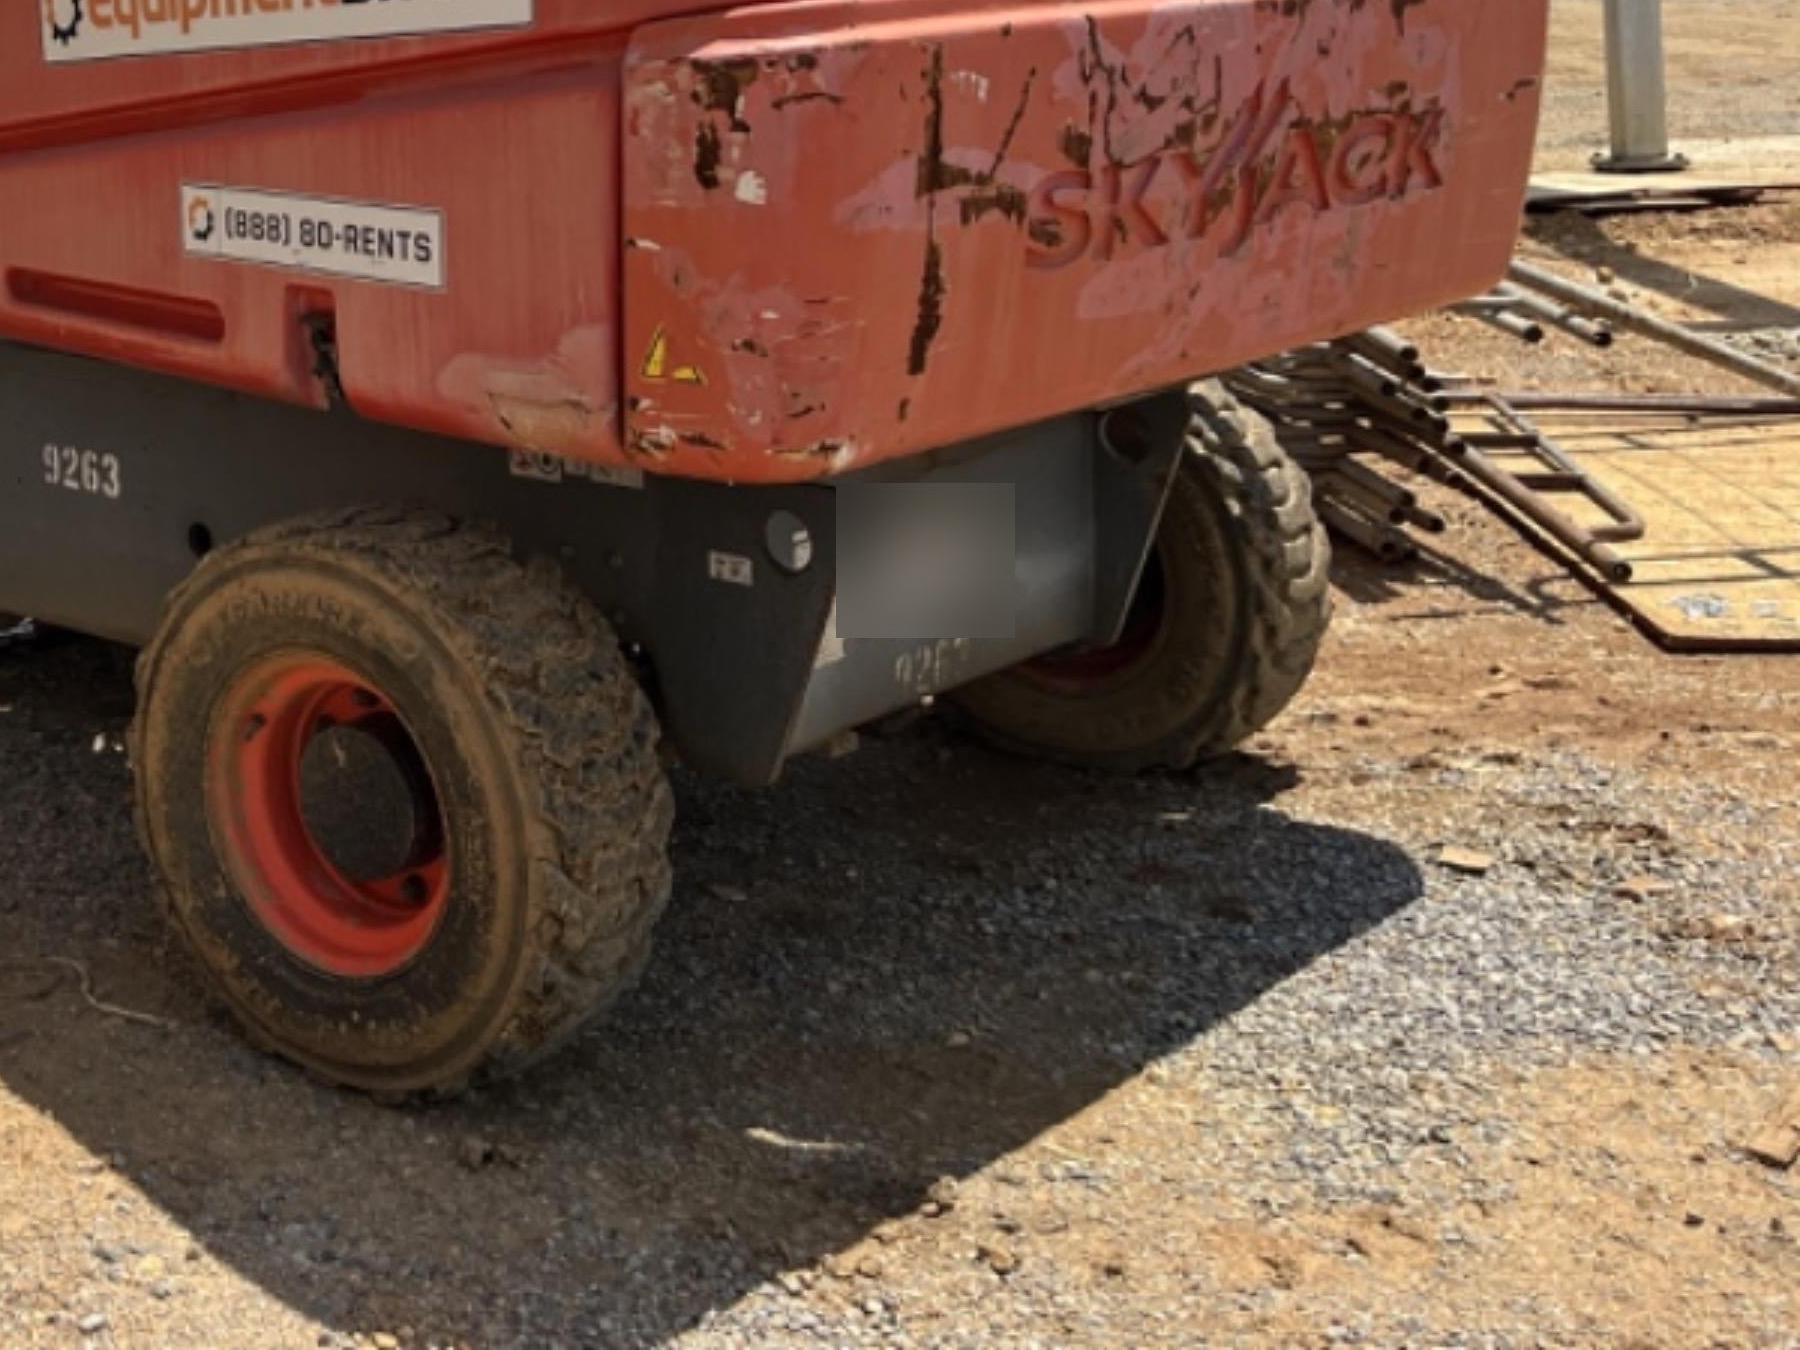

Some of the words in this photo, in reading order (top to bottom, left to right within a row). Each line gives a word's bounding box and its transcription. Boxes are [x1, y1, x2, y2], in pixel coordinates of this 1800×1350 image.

[1024, 74, 1446, 270] SKYJACK
[223, 205, 293, 247] (888)
[40, 441, 121, 500] 9263
